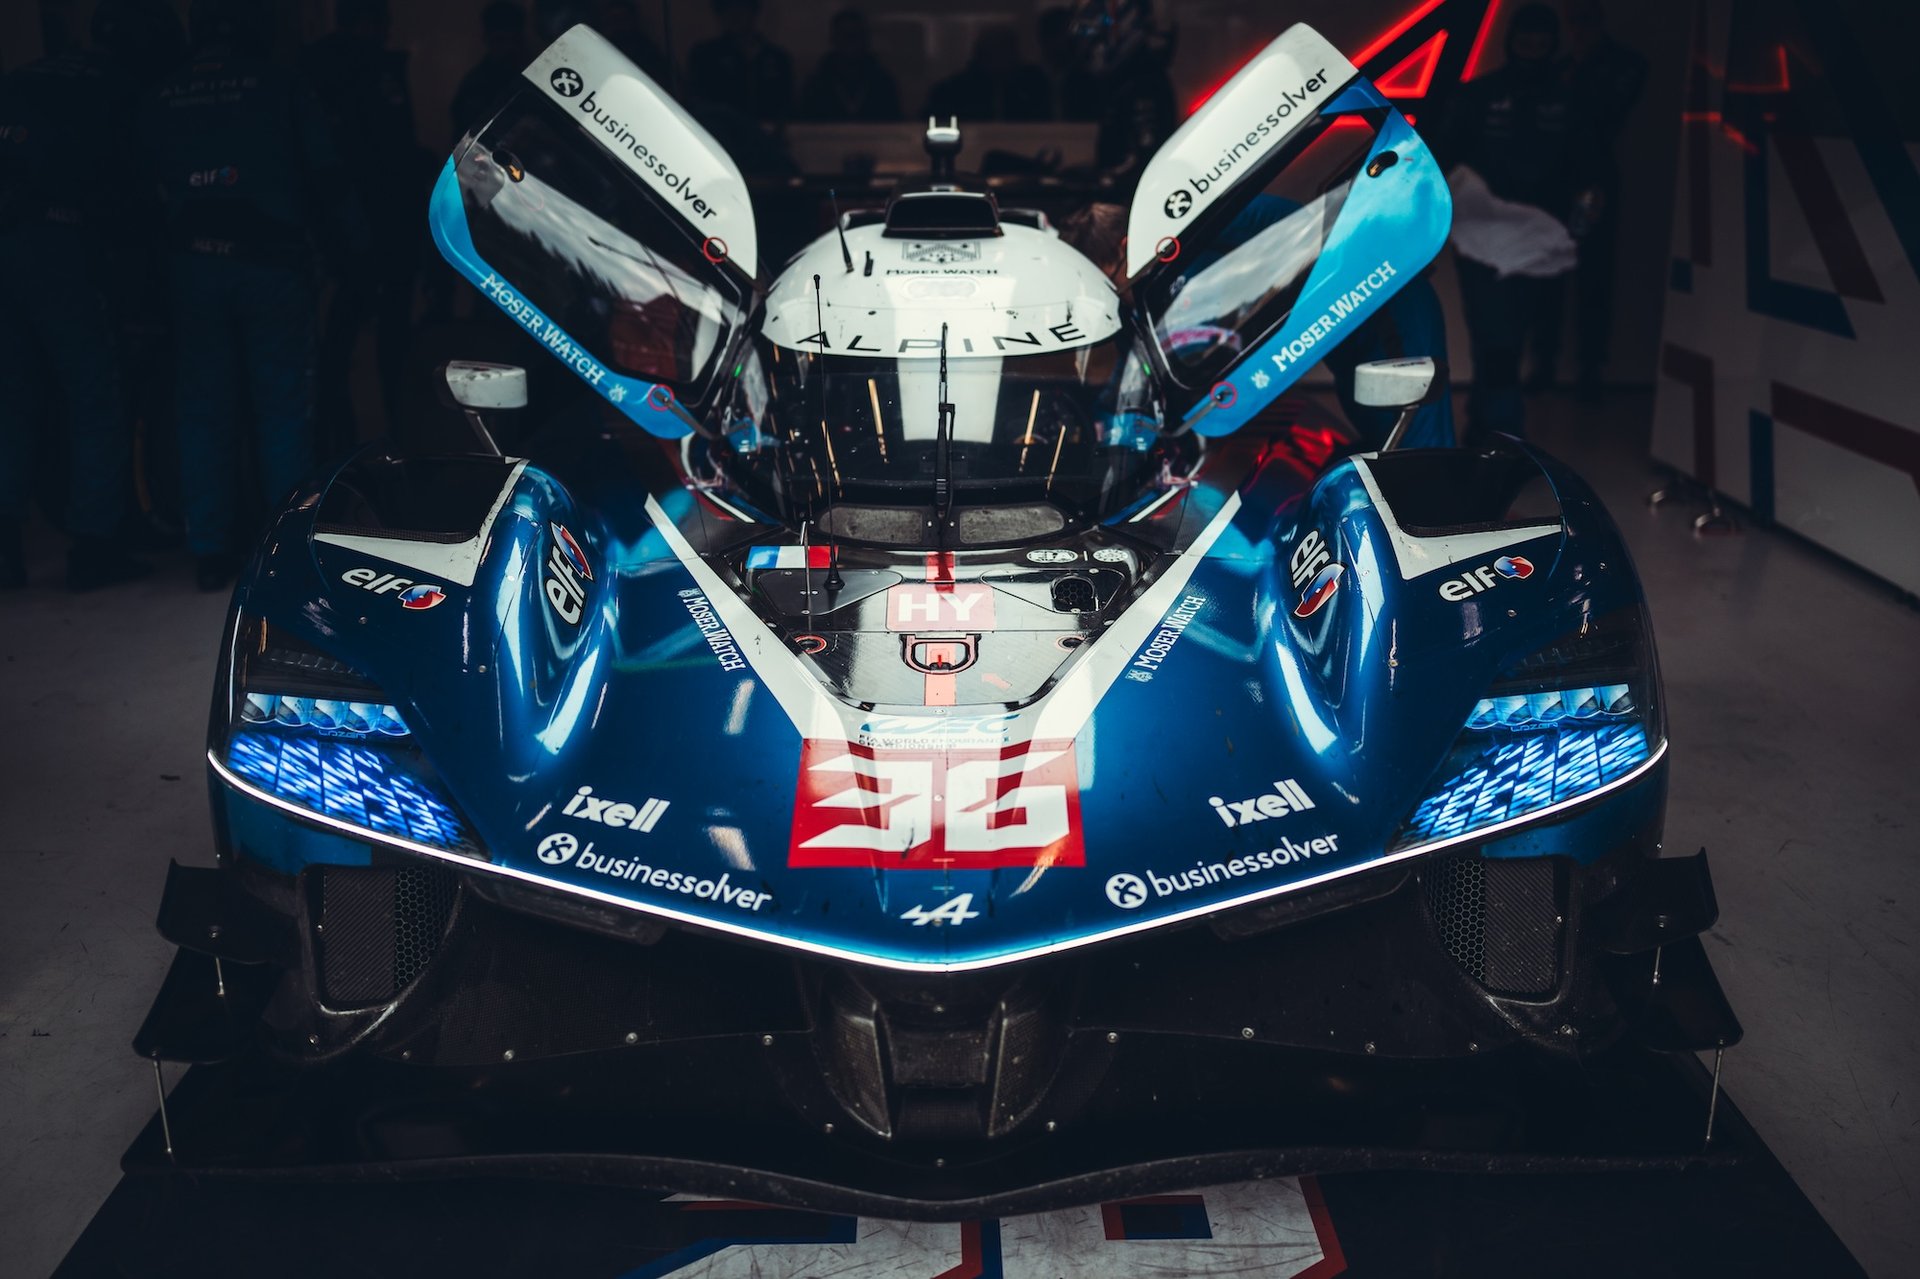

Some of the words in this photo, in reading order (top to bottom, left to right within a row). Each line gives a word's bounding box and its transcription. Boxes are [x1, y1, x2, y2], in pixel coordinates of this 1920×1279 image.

[579, 91, 717, 219] businessolver
[1190, 68, 1328, 194] businessolver
[189, 168, 217, 187] elf
[480, 273, 606, 387] MOSER.WATCH
[796, 322, 1086, 353] ALPINE
[1271, 260, 1398, 373] MOSER.WATCH
[341, 567, 412, 595] elf
[548, 545, 585, 625] elf
[1290, 530, 1331, 589] elf
[1438, 566, 1497, 602] elf
[682, 596, 747, 672] MOSER.WATCH
[898, 592, 984, 622] HY
[1133, 595, 1206, 671] MOSER.WATCH
[561, 785, 671, 834] ixell
[798, 750, 1070, 852] 36
[1208, 778, 1316, 828] ixell
[575, 842, 773, 912] businessolver
[1146, 833, 1340, 897] businessolver
